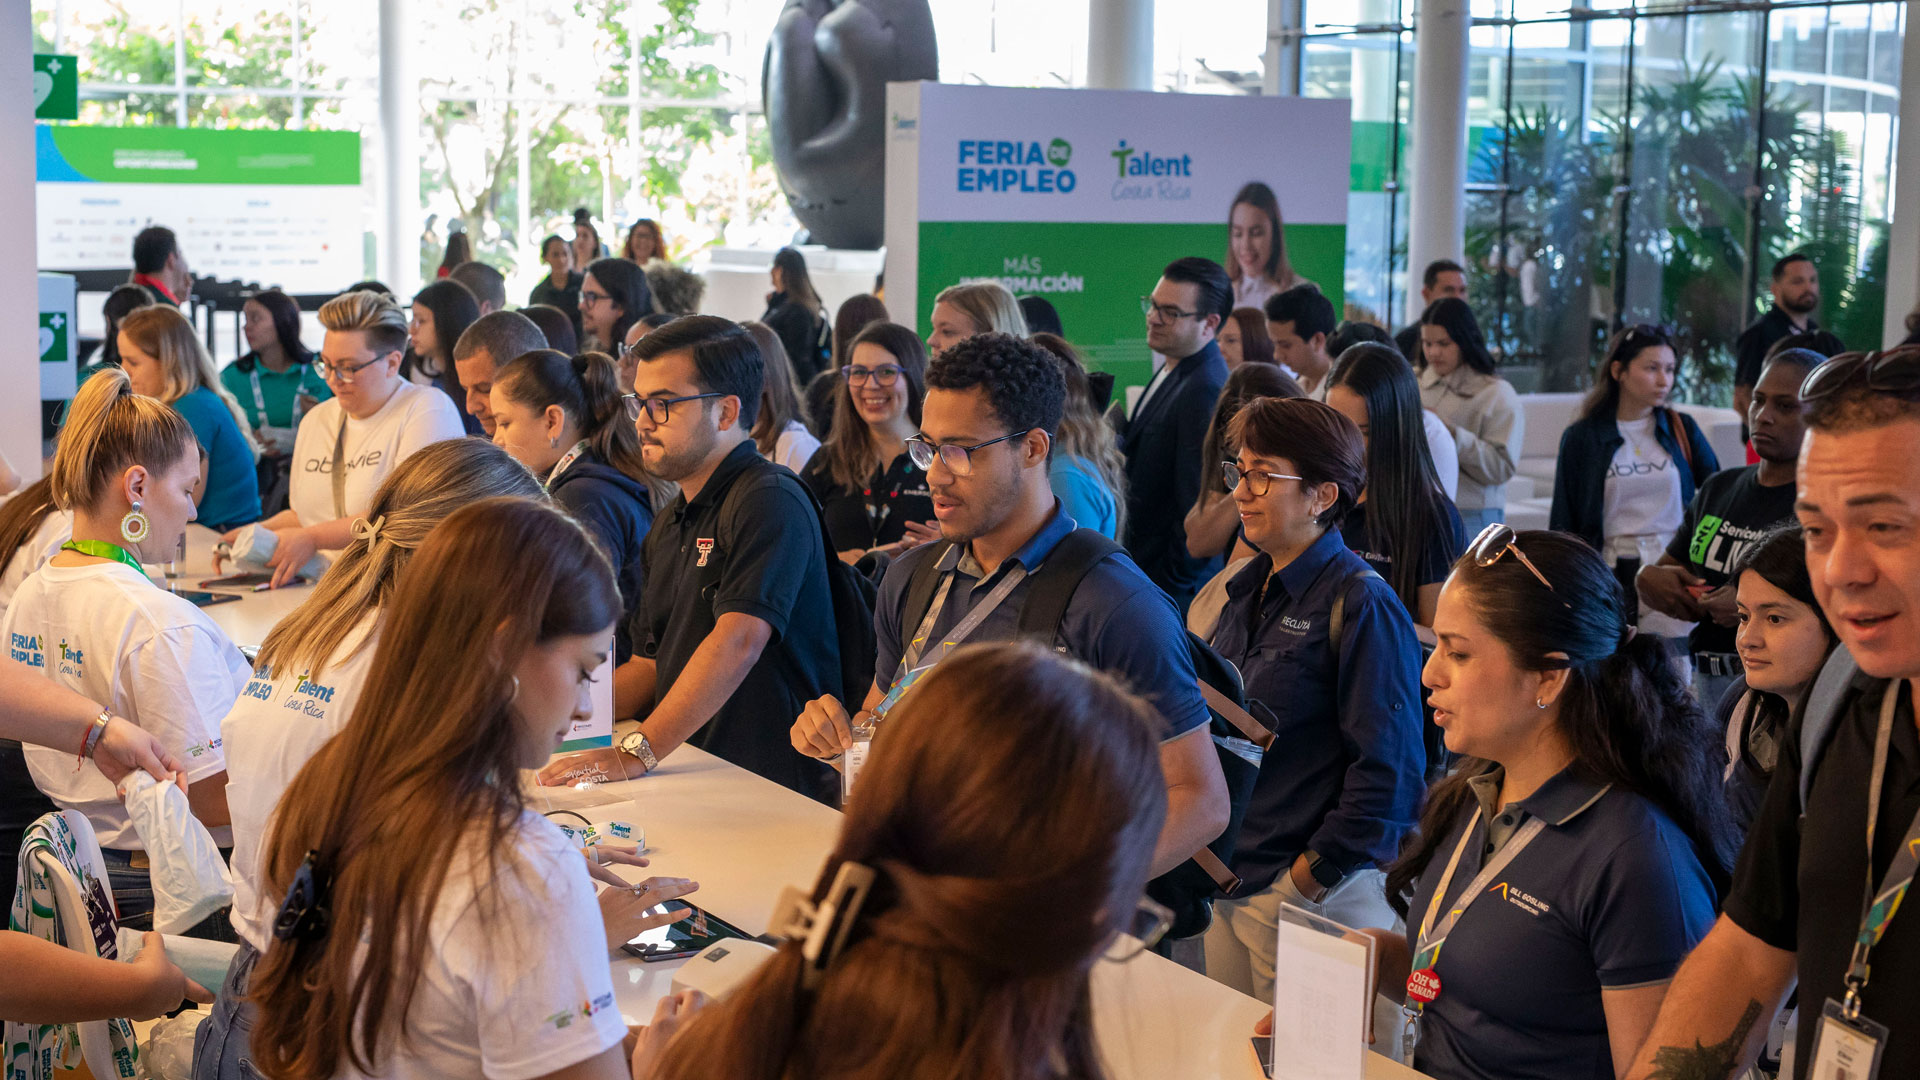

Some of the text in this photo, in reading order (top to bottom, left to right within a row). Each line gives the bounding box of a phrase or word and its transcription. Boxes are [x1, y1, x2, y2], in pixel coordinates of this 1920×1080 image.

[958, 140, 1045, 166] FERIA
[1111, 139, 1191, 178] Talent
[957, 167, 1076, 193] EMPLEO
[1003, 254, 1042, 274] MÁS
[960, 271, 1084, 293] RMACIÓN
[304, 450, 382, 475] abvie
[1606, 459, 1667, 478] abbv
[1692, 522, 1715, 555] SNL
[1720, 520, 1768, 541] ServiceN
[1705, 534, 1753, 574] LIV
[294, 669, 335, 703] Talent
[303, 699, 325, 720] Rica
[1509, 886, 1550, 912] BILL GOSLING
[1407, 982, 1436, 1001] CANADA
[1413, 971, 1430, 987] OH
